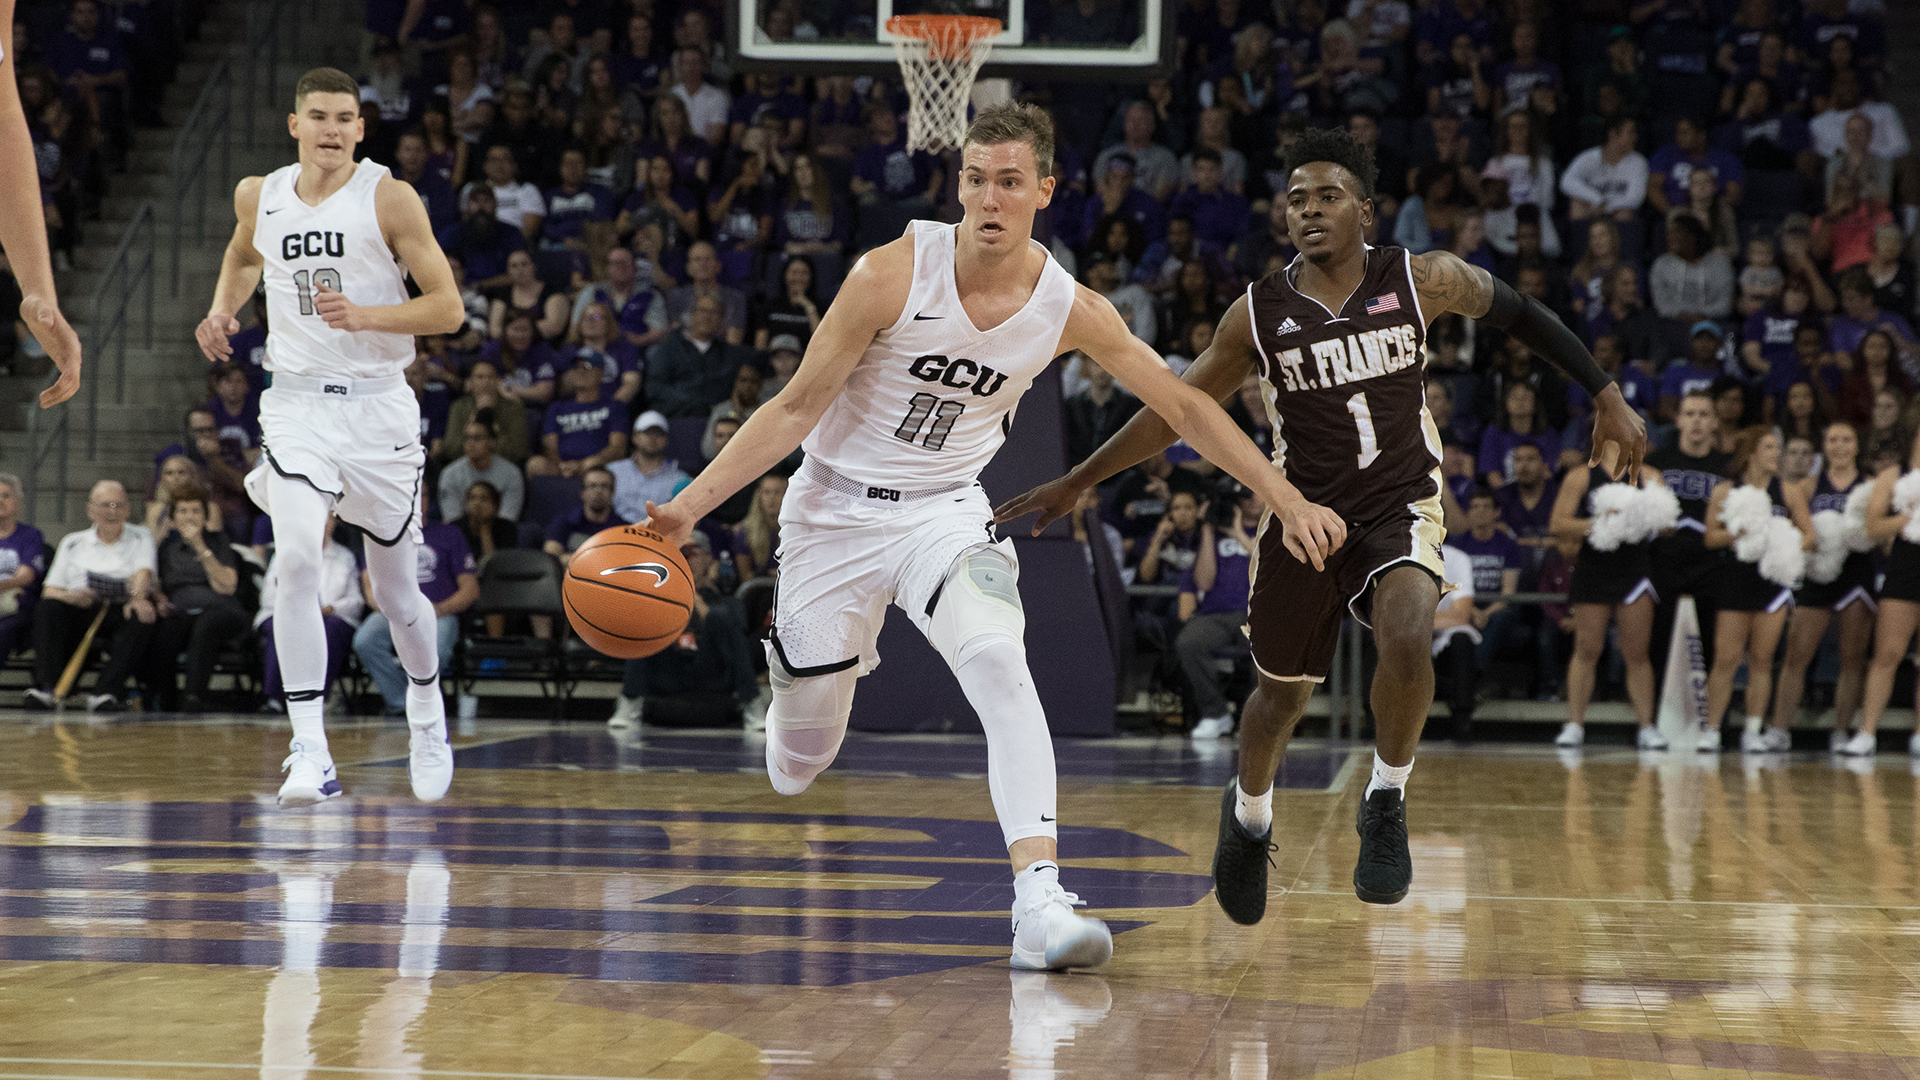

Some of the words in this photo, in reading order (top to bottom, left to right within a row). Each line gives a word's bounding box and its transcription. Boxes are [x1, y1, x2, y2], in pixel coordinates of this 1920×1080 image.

[282, 230, 345, 261] GCU
[1276, 325, 1302, 337] adidas
[1310, 323, 1416, 390] FRANCIS
[323, 384, 348, 396] GCU
[908, 354, 1010, 397] GCU
[894, 392, 967, 452] 11
[1346, 391, 1383, 470] 1
[866, 486, 902, 502] GCU
